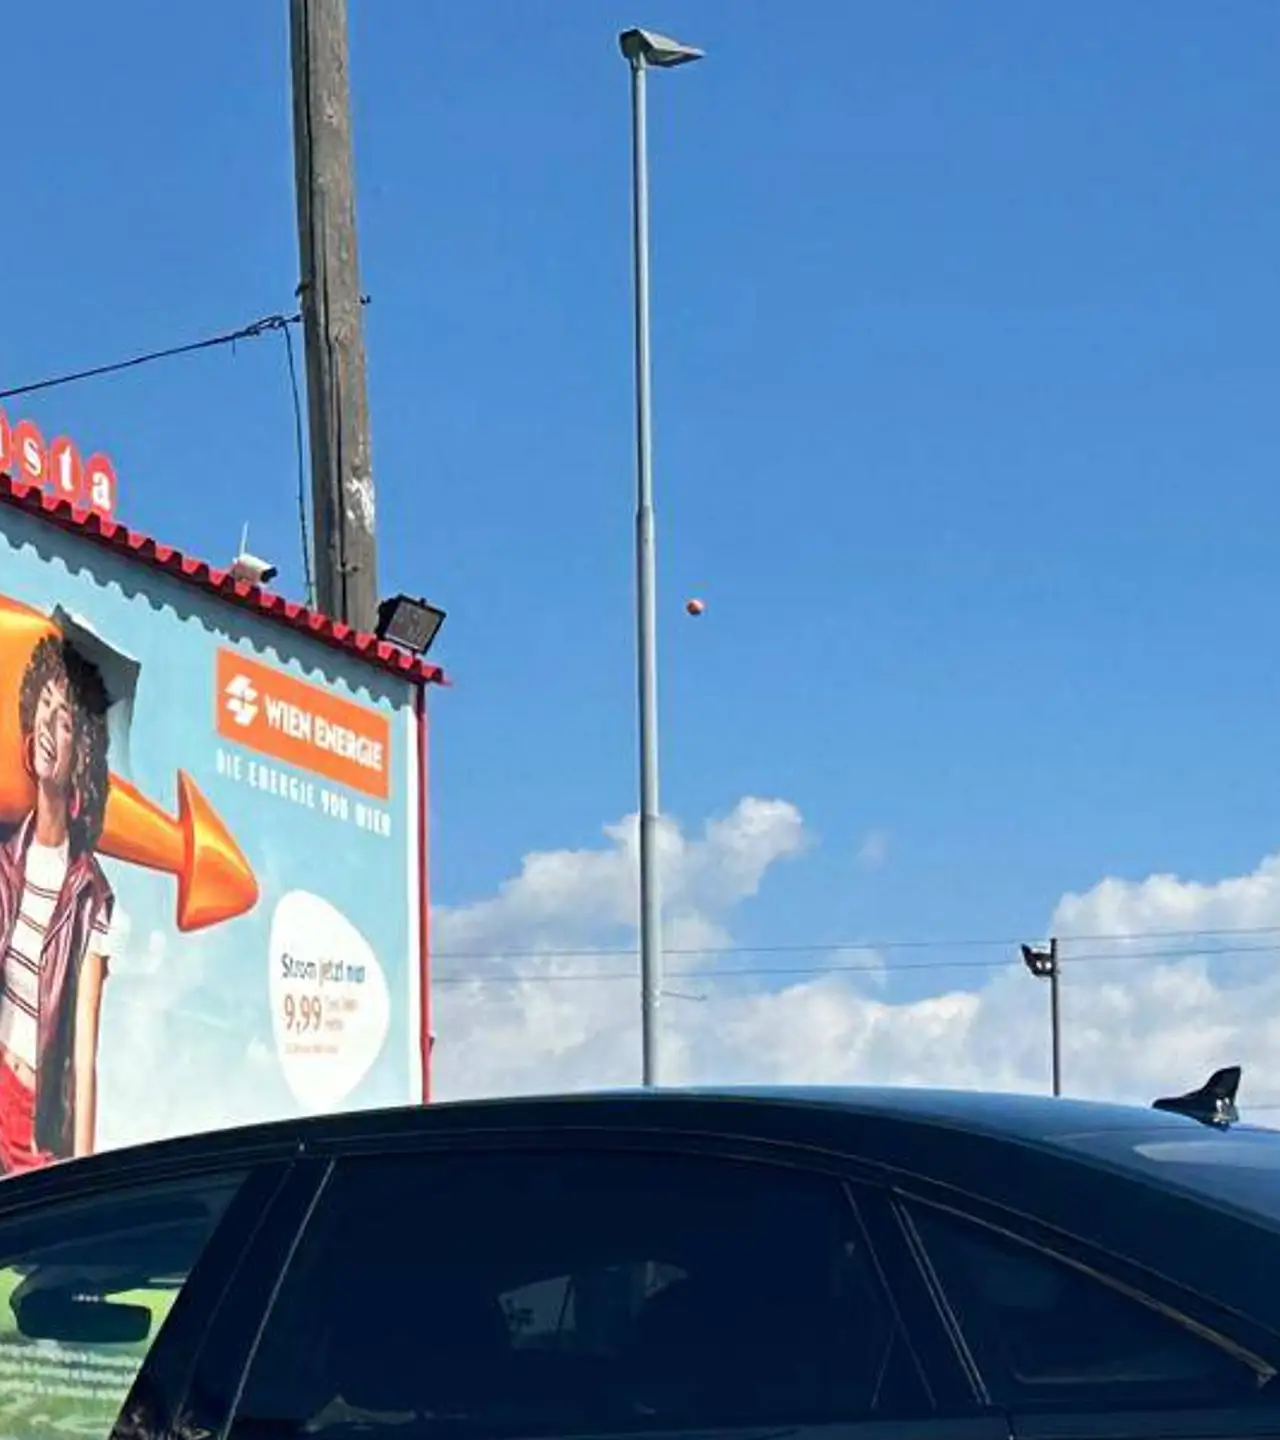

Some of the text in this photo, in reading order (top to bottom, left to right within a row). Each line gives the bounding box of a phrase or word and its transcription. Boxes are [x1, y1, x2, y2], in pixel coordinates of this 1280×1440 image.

[264, 692, 385, 773] WIEN ENERGIE
[284, 993, 322, 1036] 9,99
